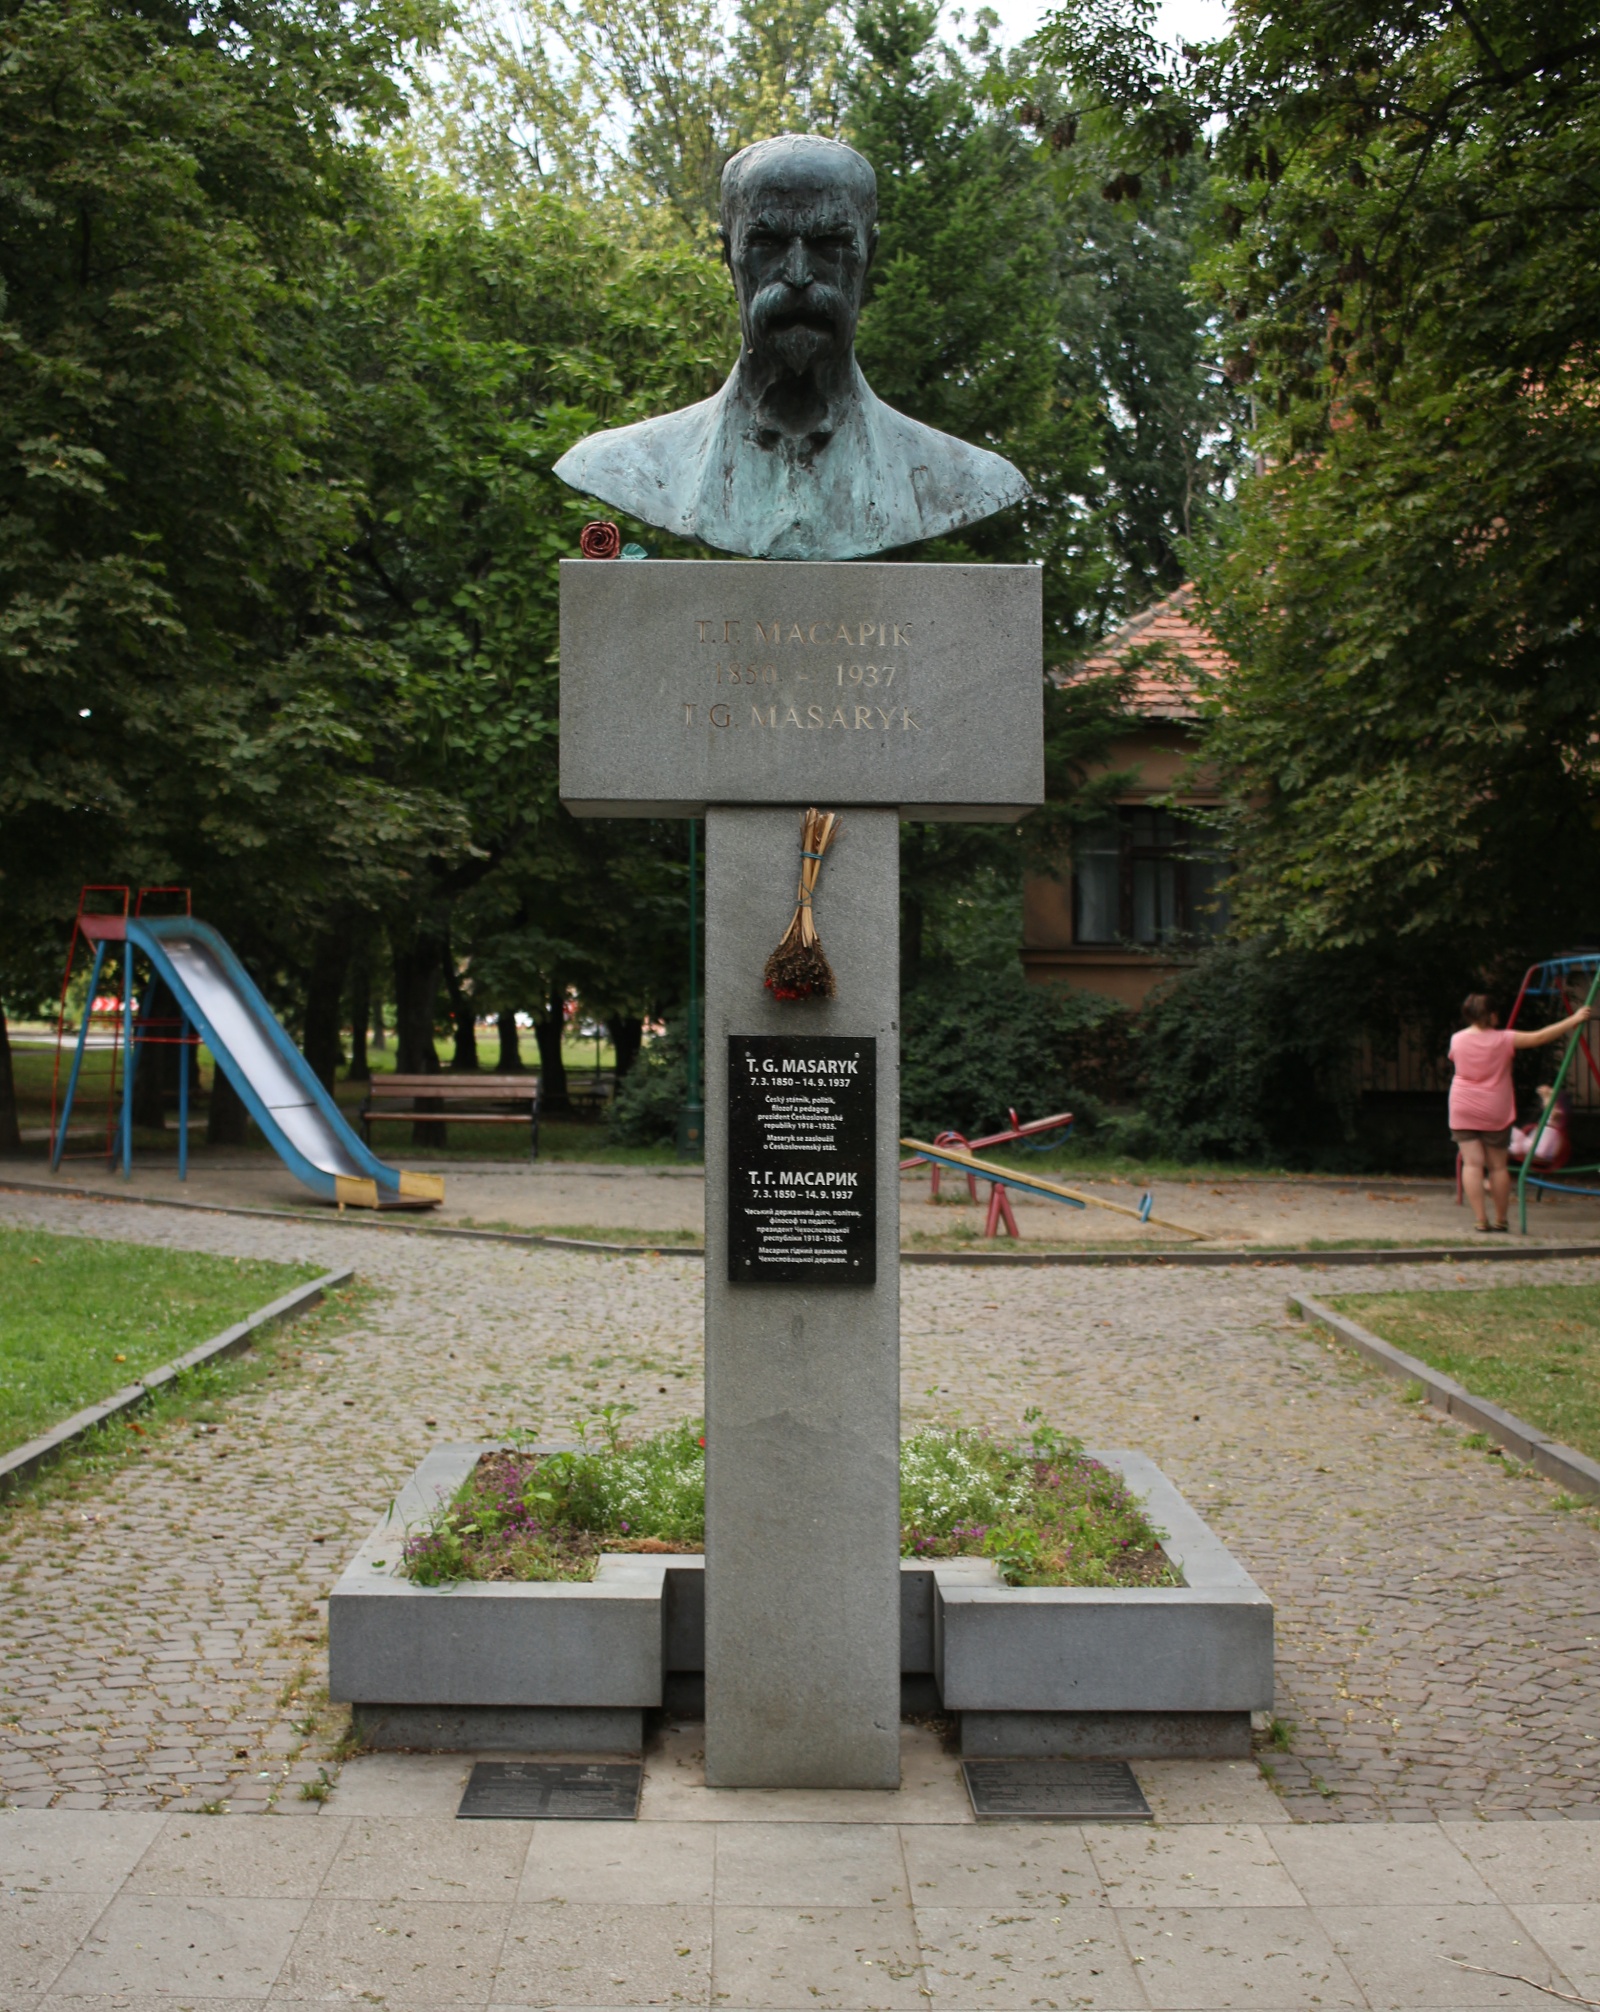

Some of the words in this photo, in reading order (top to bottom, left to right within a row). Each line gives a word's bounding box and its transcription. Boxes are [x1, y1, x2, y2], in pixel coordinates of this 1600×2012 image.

[756, 621, 913, 646] МАСАРІК
[716, 662, 777, 685] 1850
[836, 664, 896, 687] 1937
[751, 704, 922, 730] MASARYK
[746, 1059, 759, 1072] T.
[763, 1059, 778, 1072] G.
[782, 1060, 858, 1074] MASARYK
[771, 1078, 793, 1086] 1850
[829, 1079, 850, 1087] 1937
[765, 1095, 784, 1104] Český
[748, 1171, 761, 1184] Т.
[765, 1171, 775, 1184] Г.
[780, 1172, 858, 1186] МАСАРИК
[774, 1190, 796, 1198] 1850
[831, 1191, 853, 1199] 1937
